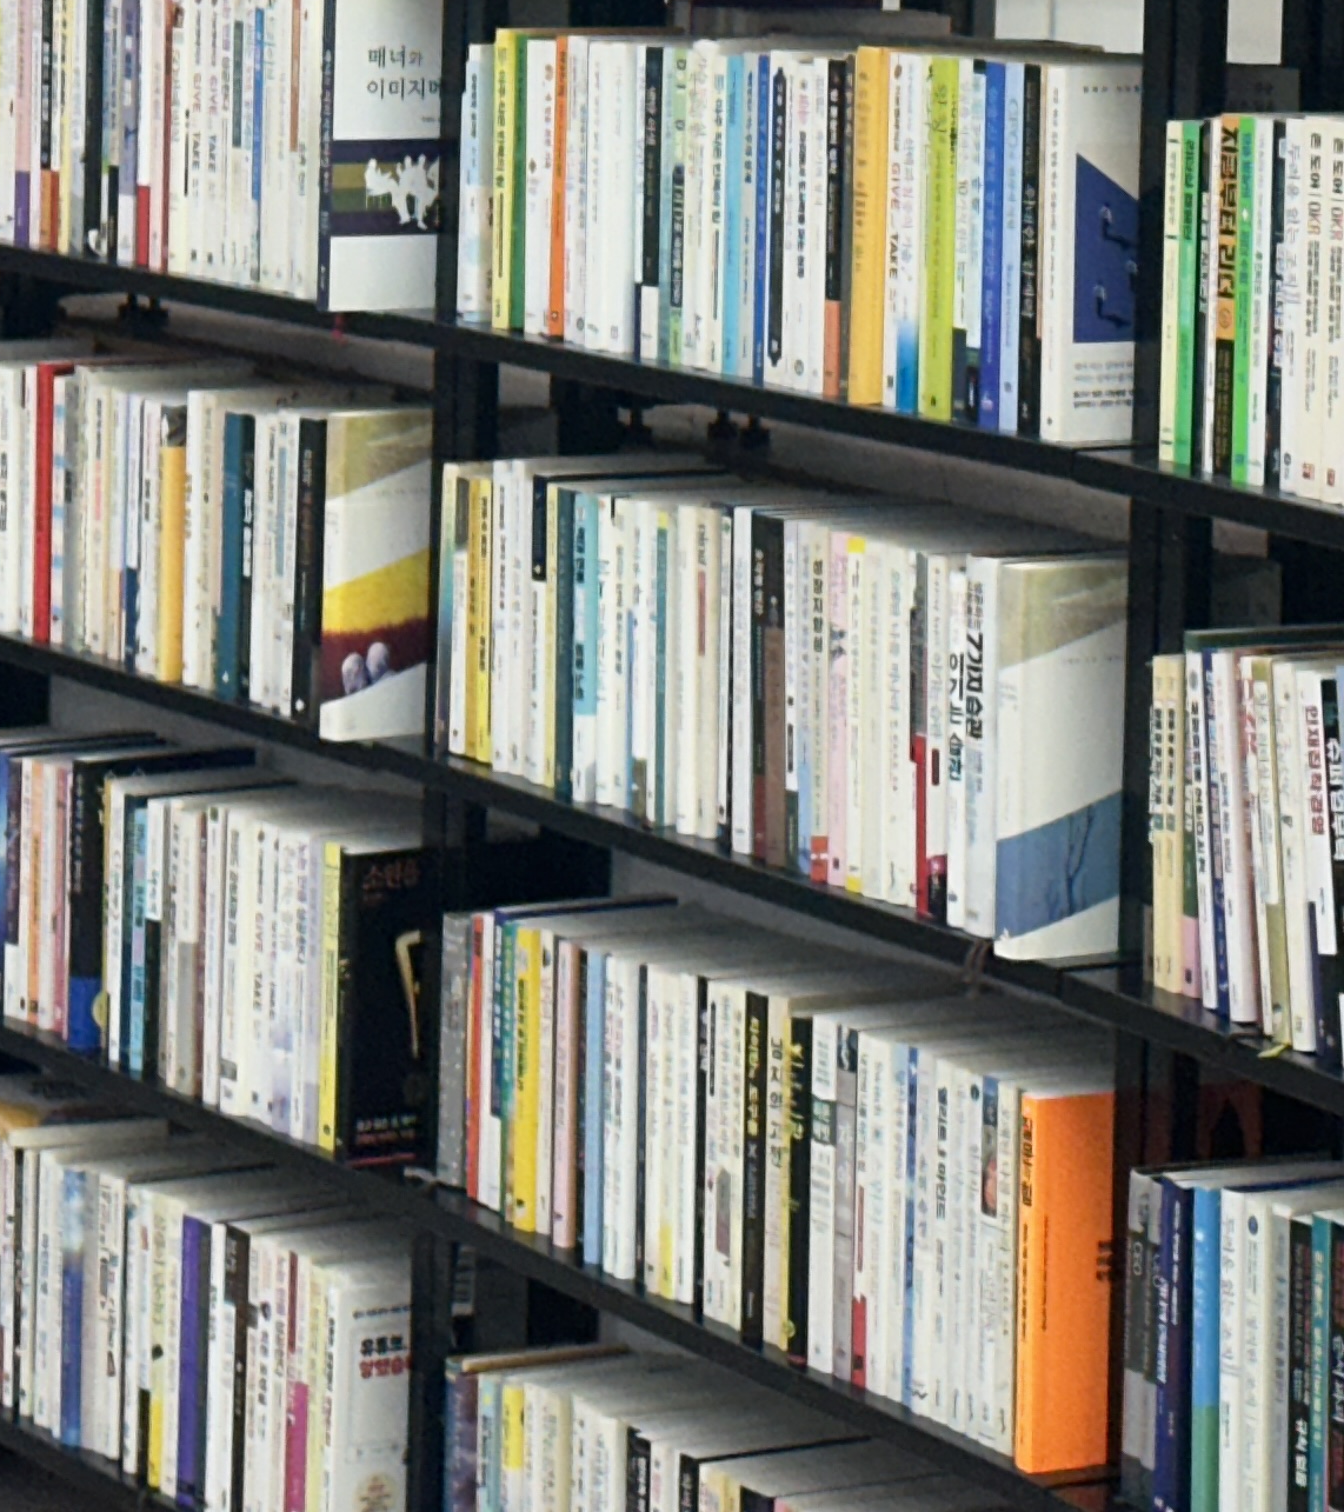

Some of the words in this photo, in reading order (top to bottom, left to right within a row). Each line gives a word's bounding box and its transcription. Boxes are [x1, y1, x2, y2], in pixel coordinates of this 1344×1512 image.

[891, 162, 900, 210] GIVE
[1218, 126, 1238, 237] 지금부터
[1310, 155, 1321, 189] 도어
[1331, 160, 1344, 195] 도어
[1286, 207, 1300, 244] 없는
[1306, 201, 1322, 236] OKR
[1330, 207, 1343, 241] OKR
[889, 232, 899, 280] TAKE
[1217, 244, 1237, 300] 리더
[965, 632, 984, 693] 7가지
[965, 696, 984, 740] 습관
